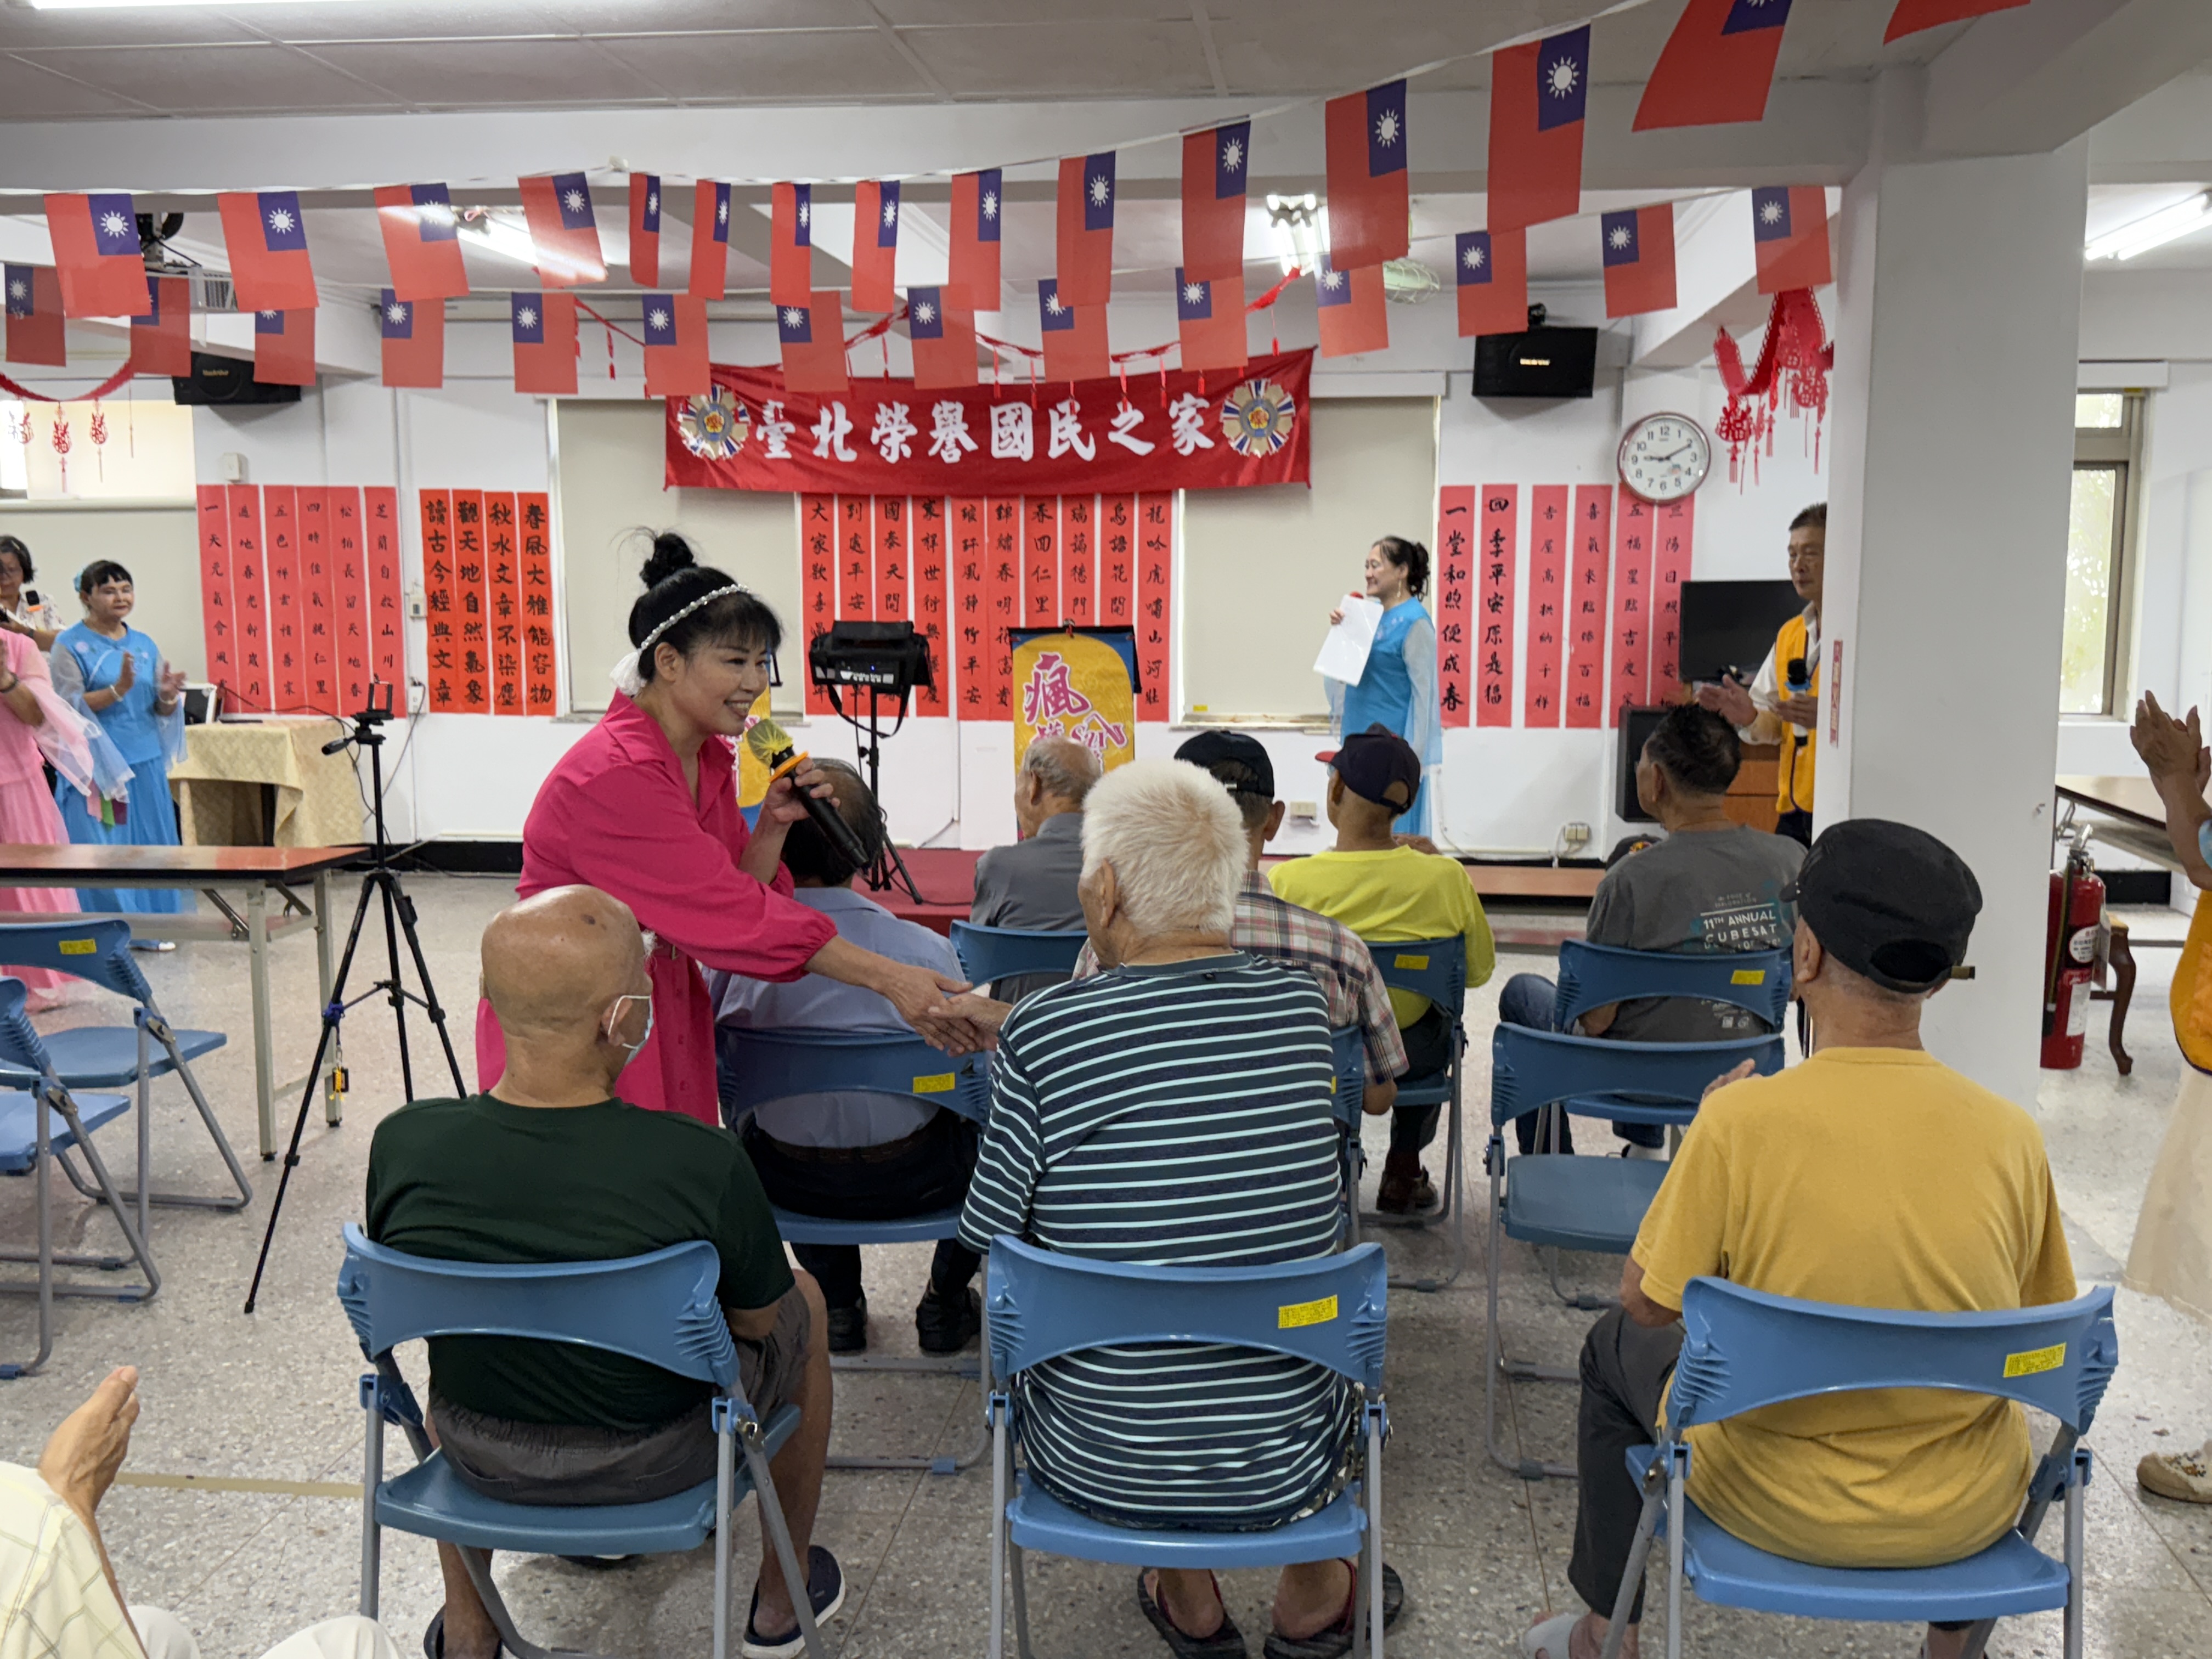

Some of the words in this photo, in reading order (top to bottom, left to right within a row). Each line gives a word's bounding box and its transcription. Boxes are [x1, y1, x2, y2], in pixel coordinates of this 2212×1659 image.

[755, 392, 1215, 462] 臺北榮譽國民之家
[1660, 426, 1670, 436] 12
[1647, 431, 1654, 440] 11
[1678, 430, 1681, 438] 1
[1637, 442, 1646, 451] 10
[1631, 455, 1638, 465] 9
[1690, 452, 1697, 462] 3
[1635, 469, 1643, 478] 8
[1685, 467, 1691, 476] 4
[1647, 478, 1654, 488] 7
[1660, 481, 1667, 490] 6
[1675, 478, 1681, 487] 5
[426, 498, 453, 707] 讀古今經典文章
[458, 500, 486, 704] 觀天地自然氣象
[490, 501, 517, 706] 秋水文章不染塵
[525, 503, 552, 704] 春風大雅能容物
[1144, 503, 1167, 706] 龍吟虎嘯山河壯
[1485, 497, 1509, 705] 四季平安原是福
[1703, 916, 1724, 930] 11TH
[1728, 909, 1776, 927] ANNUAL
[1705, 923, 1777, 943] CUBESAT
